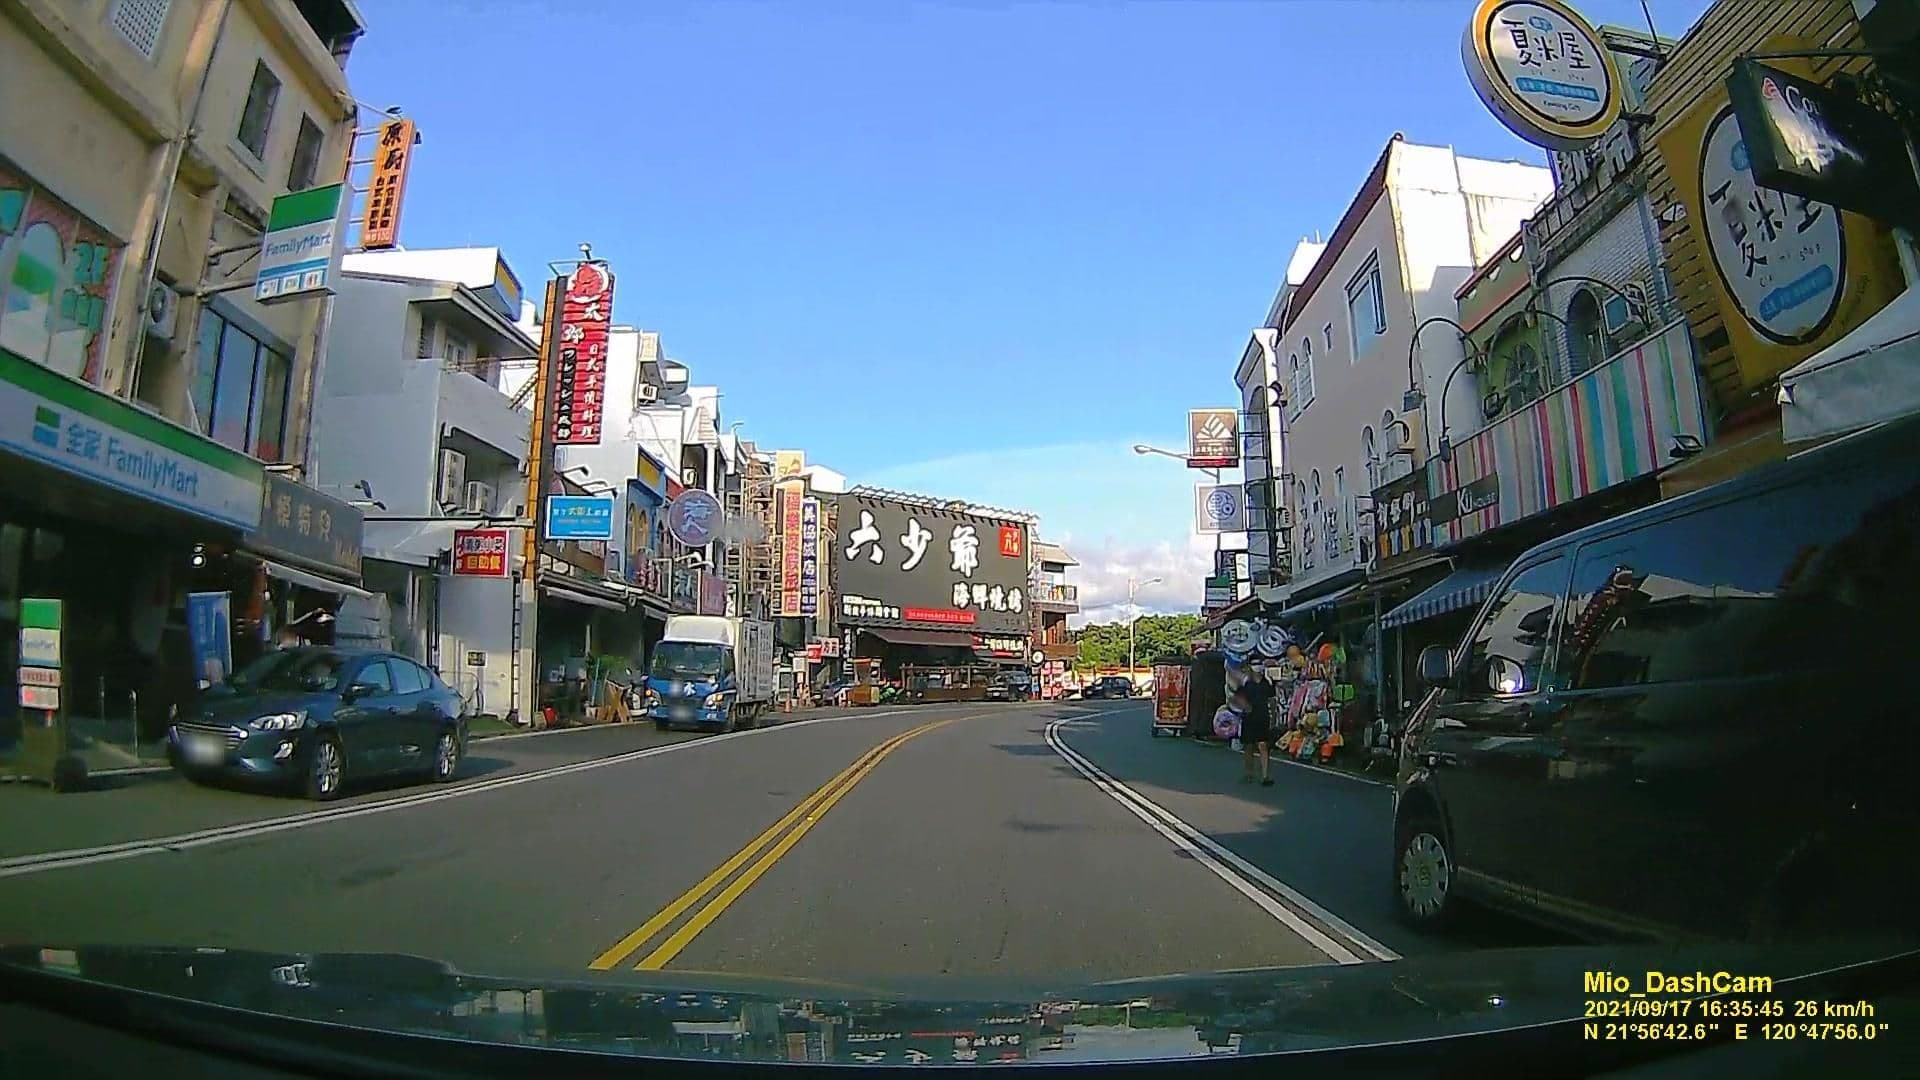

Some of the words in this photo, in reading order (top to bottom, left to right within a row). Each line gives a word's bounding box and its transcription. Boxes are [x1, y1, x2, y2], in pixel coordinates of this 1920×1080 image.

[1501, 18, 1591, 69] 夏米屋
[266, 230, 333, 257] FamilyMart
[66, 423, 102, 459] 全家
[106, 435, 199, 498] FamilyMart
[467, 555, 501, 569] 自助餐
[846, 510, 979, 577] 六少爺
